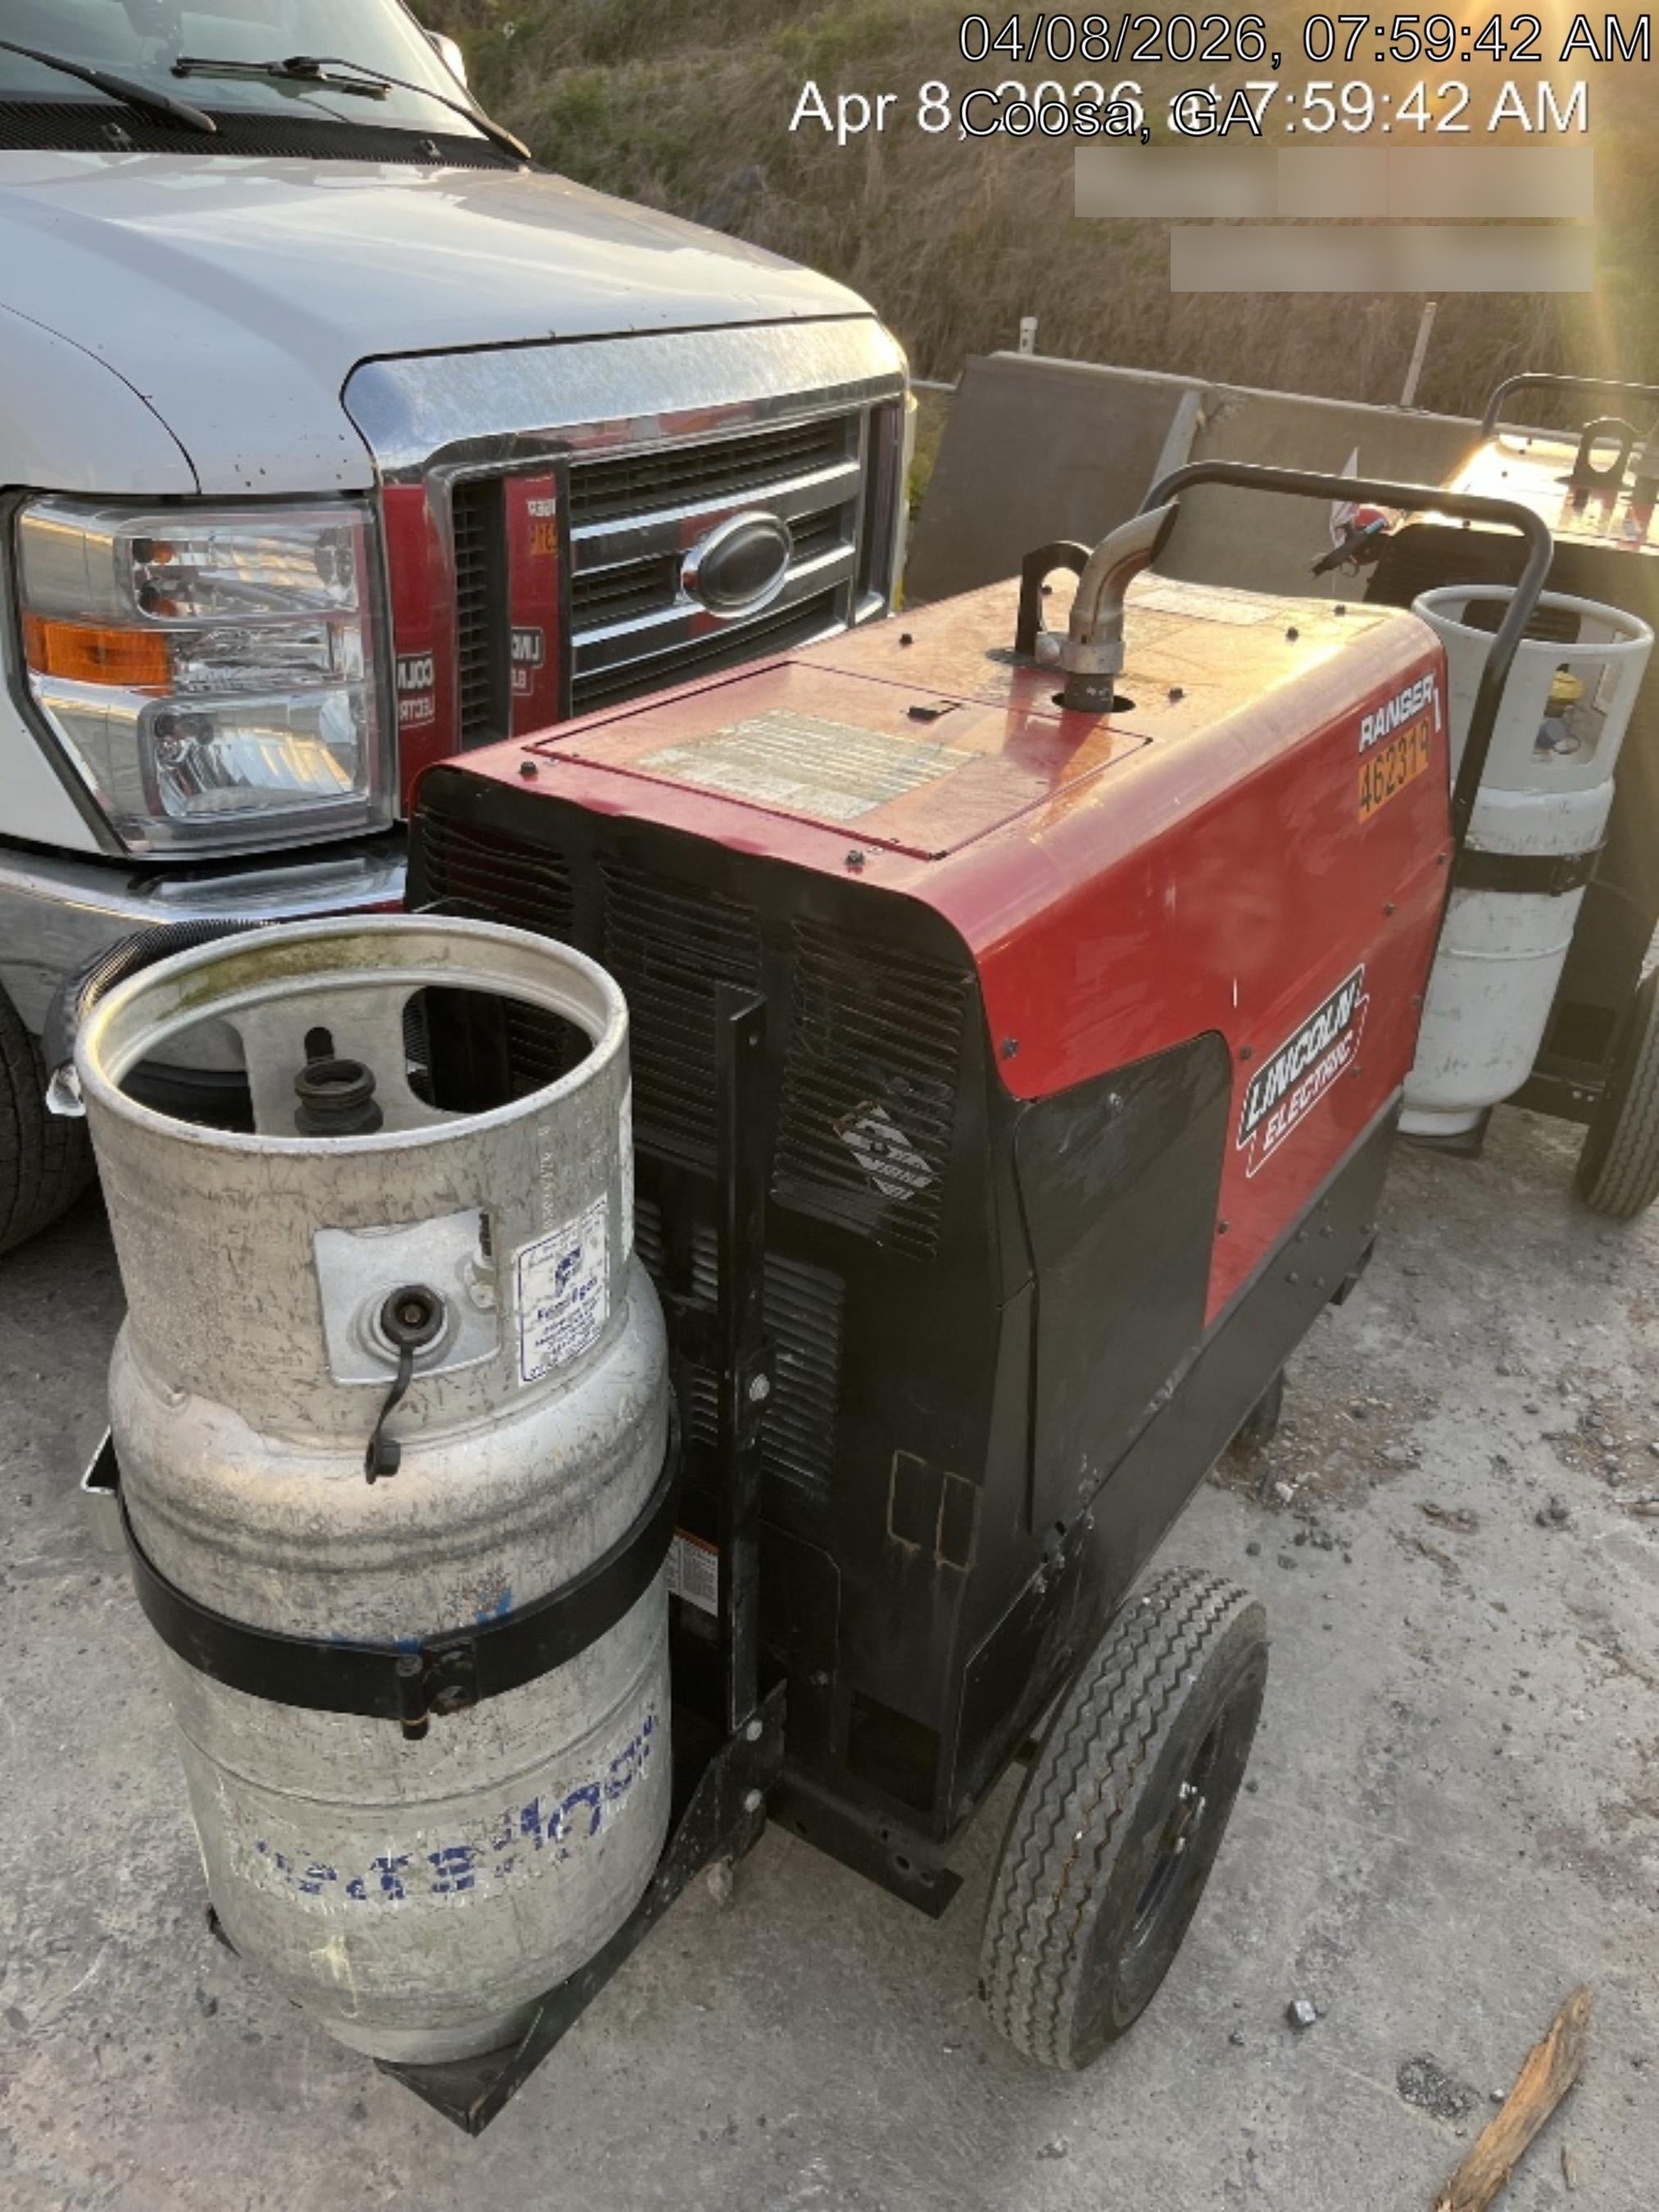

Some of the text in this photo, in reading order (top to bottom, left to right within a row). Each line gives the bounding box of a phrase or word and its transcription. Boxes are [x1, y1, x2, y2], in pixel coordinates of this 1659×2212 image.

[1358, 672, 1439, 753] RANGER
[1361, 719, 1430, 813] 462319
[1245, 982, 1356, 1131] LINCOLN
[1262, 1030, 1353, 1151] ELECTRIC
